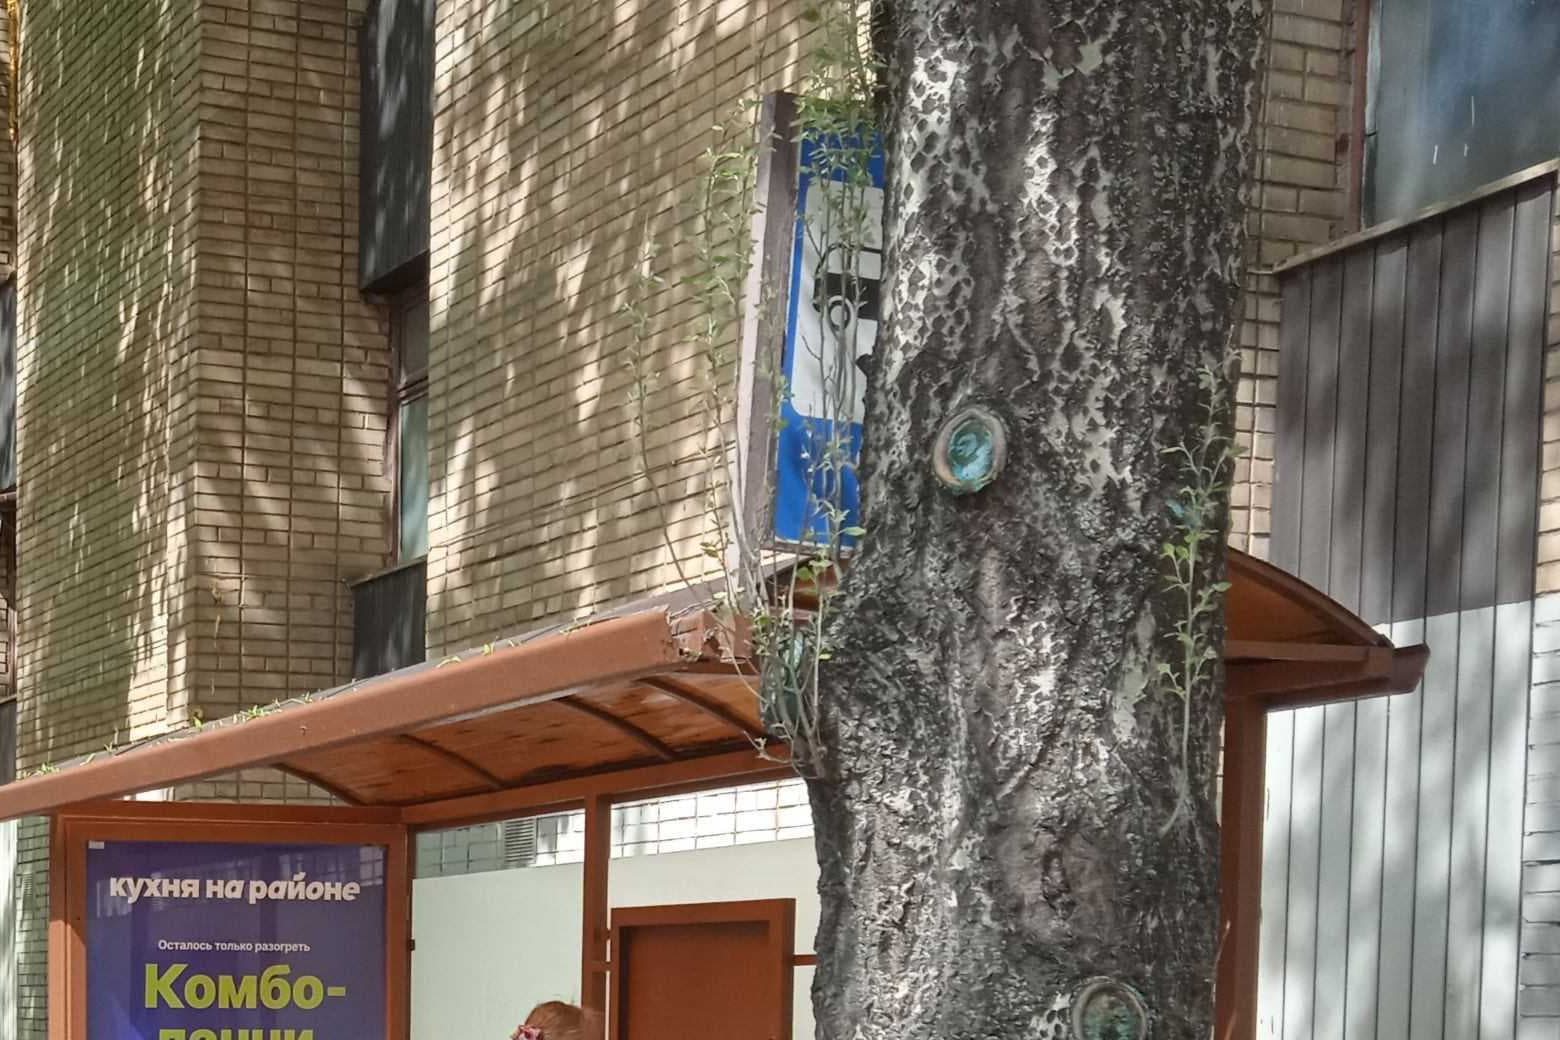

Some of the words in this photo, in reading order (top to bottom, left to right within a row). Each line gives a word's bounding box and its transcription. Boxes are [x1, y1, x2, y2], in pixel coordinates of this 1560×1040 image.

[109, 876, 200, 904] кухня
[205, 877, 245, 900] на
[249, 872, 361, 904] районе
[157, 939, 213, 952] Осталось
[214, 941, 253, 952] только
[254, 942, 311, 954] разогреть
[144, 962, 346, 1010] Комбо-
